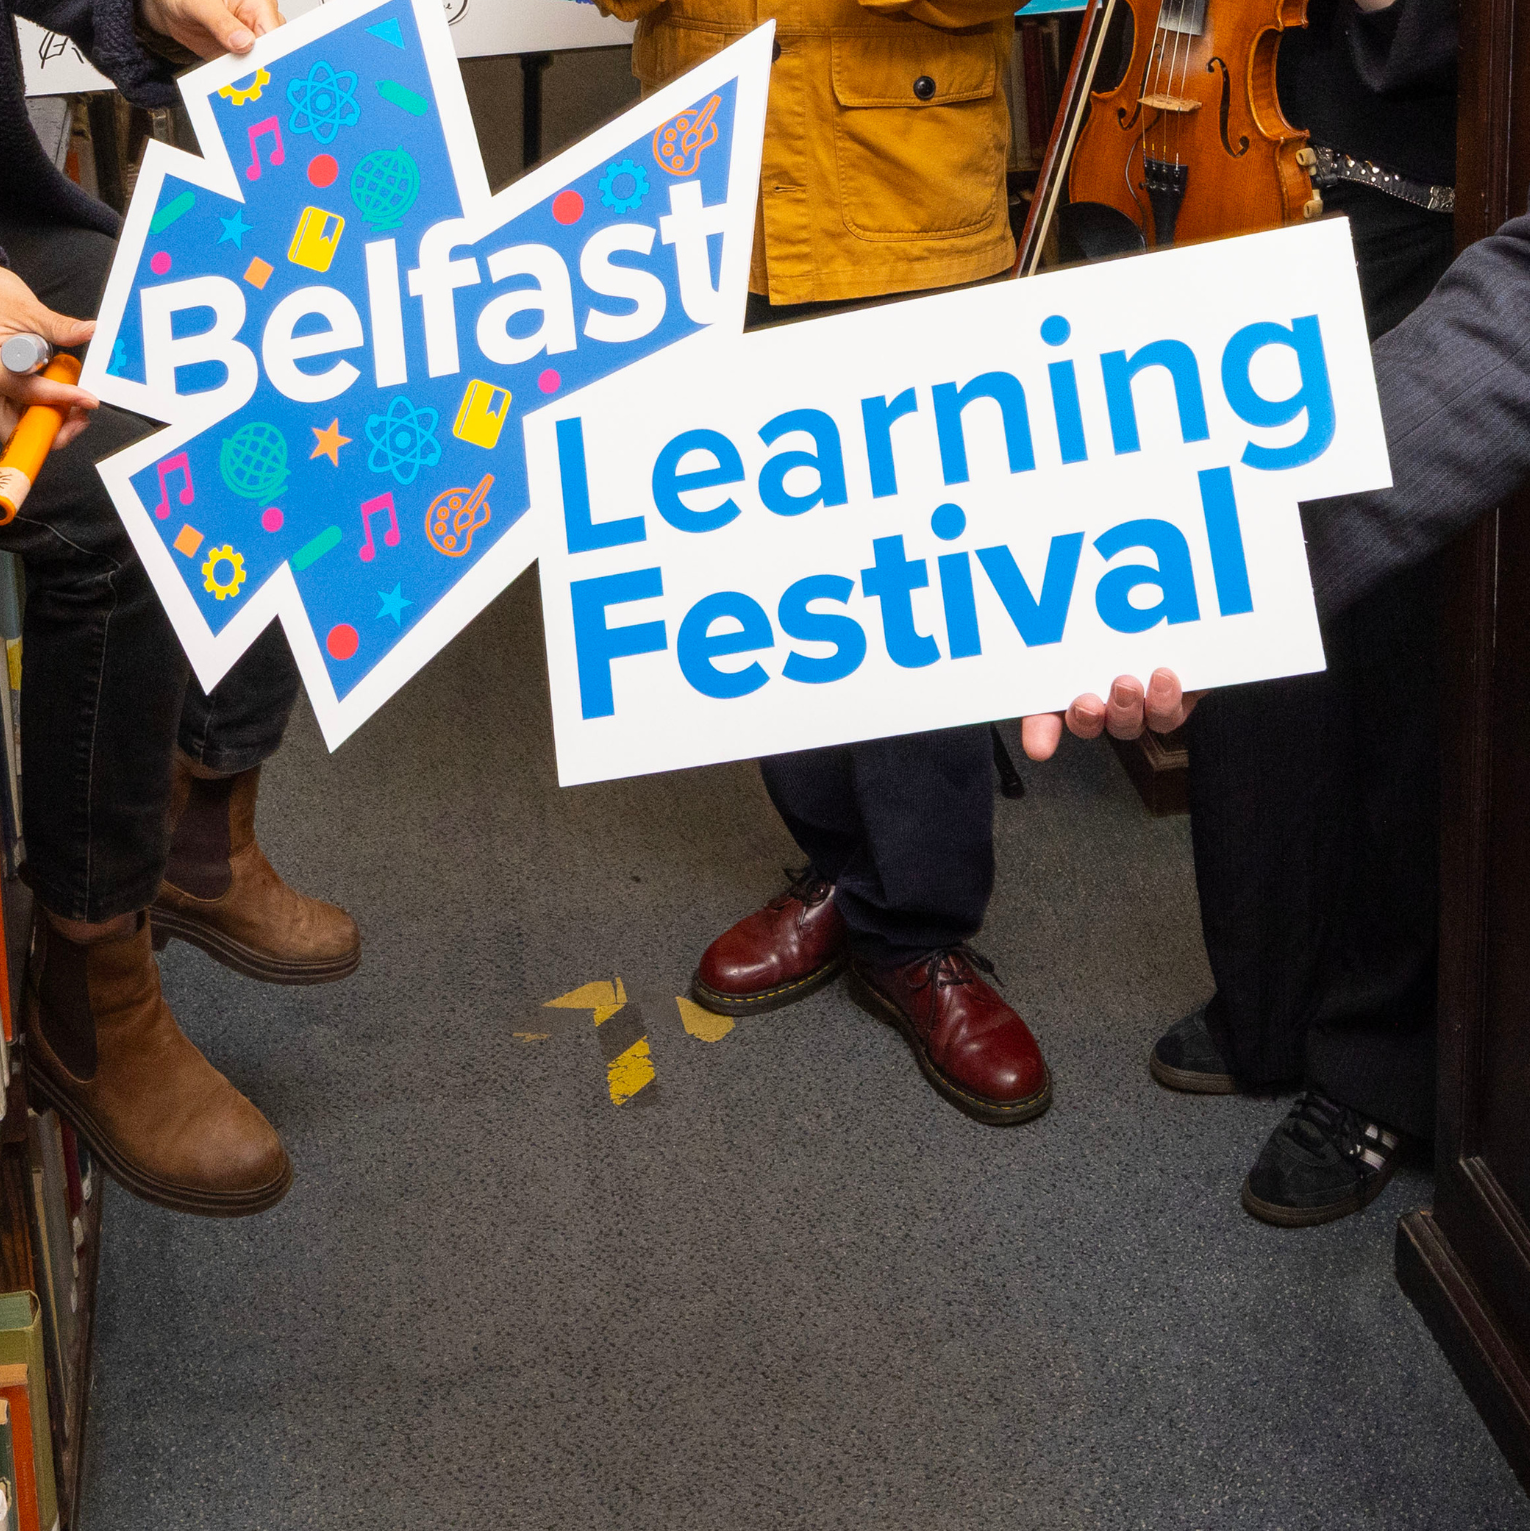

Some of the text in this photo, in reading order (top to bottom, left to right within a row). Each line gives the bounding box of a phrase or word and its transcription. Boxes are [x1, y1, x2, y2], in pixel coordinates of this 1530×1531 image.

[140, 179, 735, 403] Belfast
[556, 312, 1337, 556] Learning
[567, 465, 1255, 722] Festival
